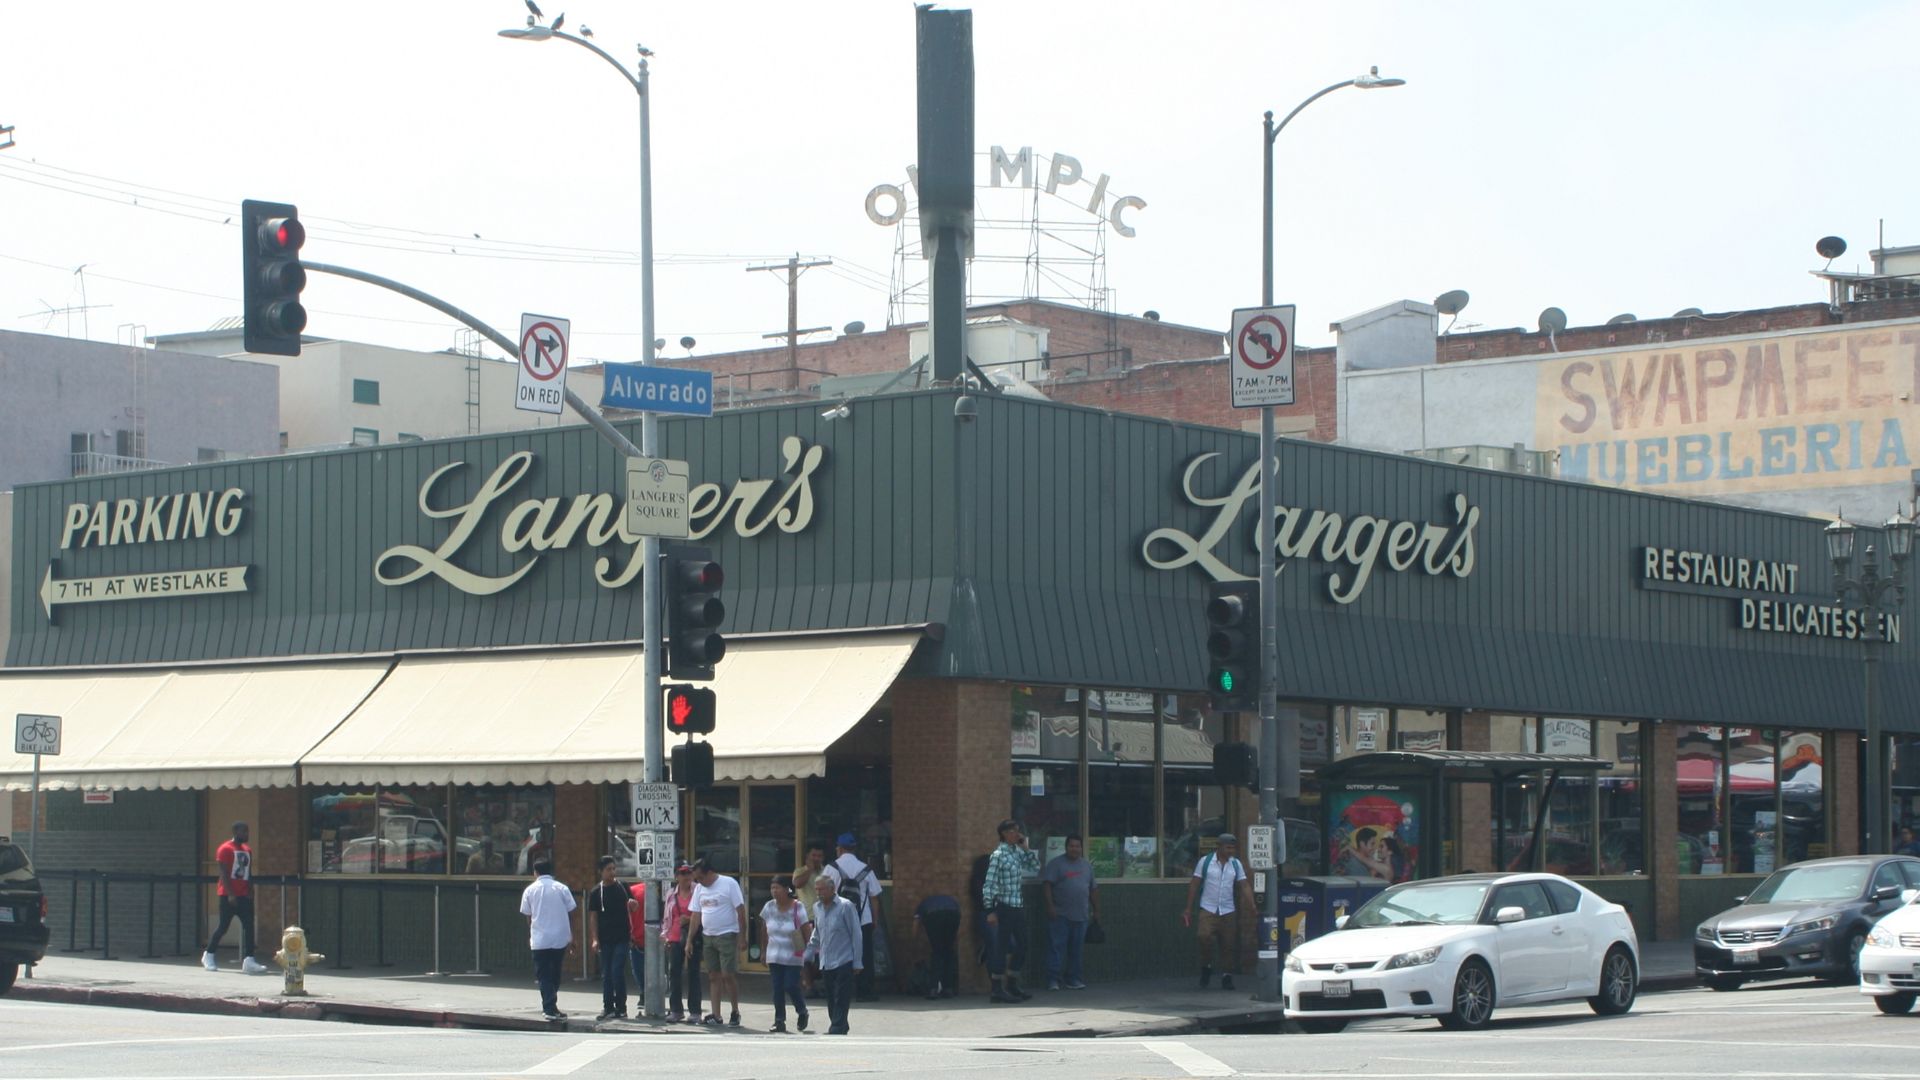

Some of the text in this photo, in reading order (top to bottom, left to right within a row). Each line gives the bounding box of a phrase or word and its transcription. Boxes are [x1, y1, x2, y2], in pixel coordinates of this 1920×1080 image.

[865, 145, 1147, 238] OMPIC
[520, 386, 560, 405] ON RED
[610, 374, 707, 404] Alvarado
[1557, 417, 1911, 487] MUEBLERIA
[631, 489, 686, 504] LANGER'S
[636, 504, 680, 518] SQUARE
[60, 487, 244, 549] PARKING
[375, 435, 823, 595] Laner's
[1142, 452, 1480, 604] Langer's
[105, 580, 125, 595] AT
[134, 572, 228, 592] WESTLAKE
[1644, 546, 1798, 594] RESTAURANT
[1742, 598, 1900, 643] DELICATESN
[21, 743, 37, 751] BIKE
[638, 785, 671, 793] DIAGONAL
[635, 807, 652, 825] OK
